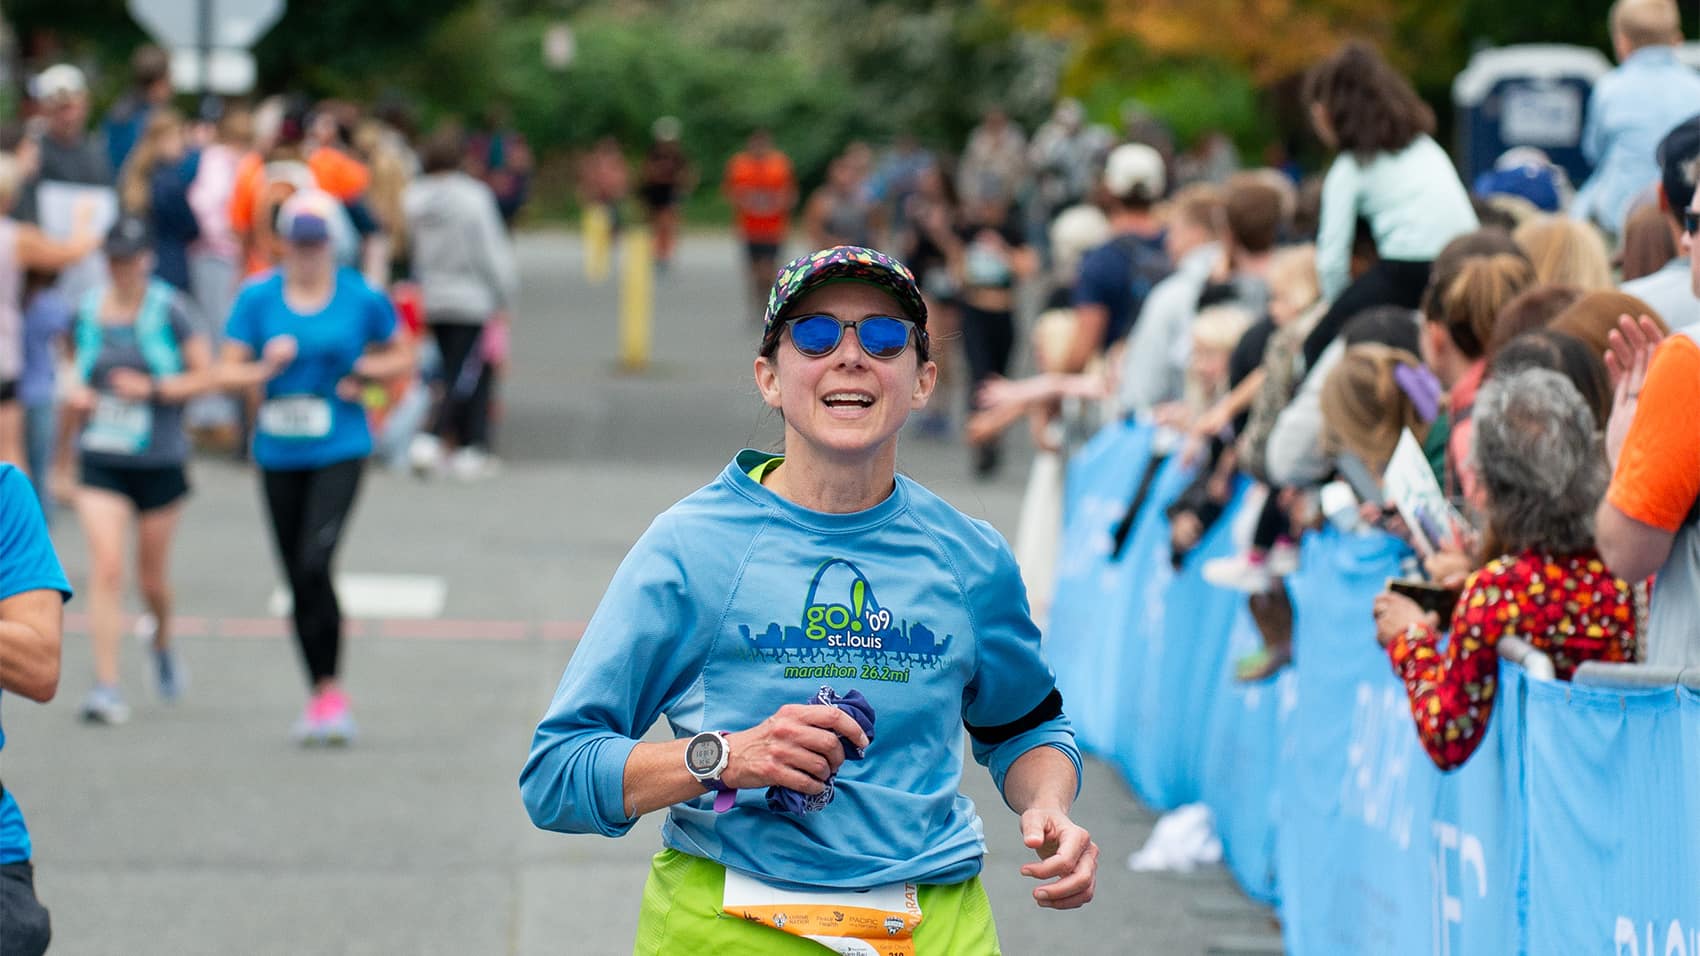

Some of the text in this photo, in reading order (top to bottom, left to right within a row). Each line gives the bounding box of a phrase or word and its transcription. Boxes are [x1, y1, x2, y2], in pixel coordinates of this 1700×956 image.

[805, 579, 890, 640] go! '09
[784, 663, 910, 682] marathon 26.2mi
